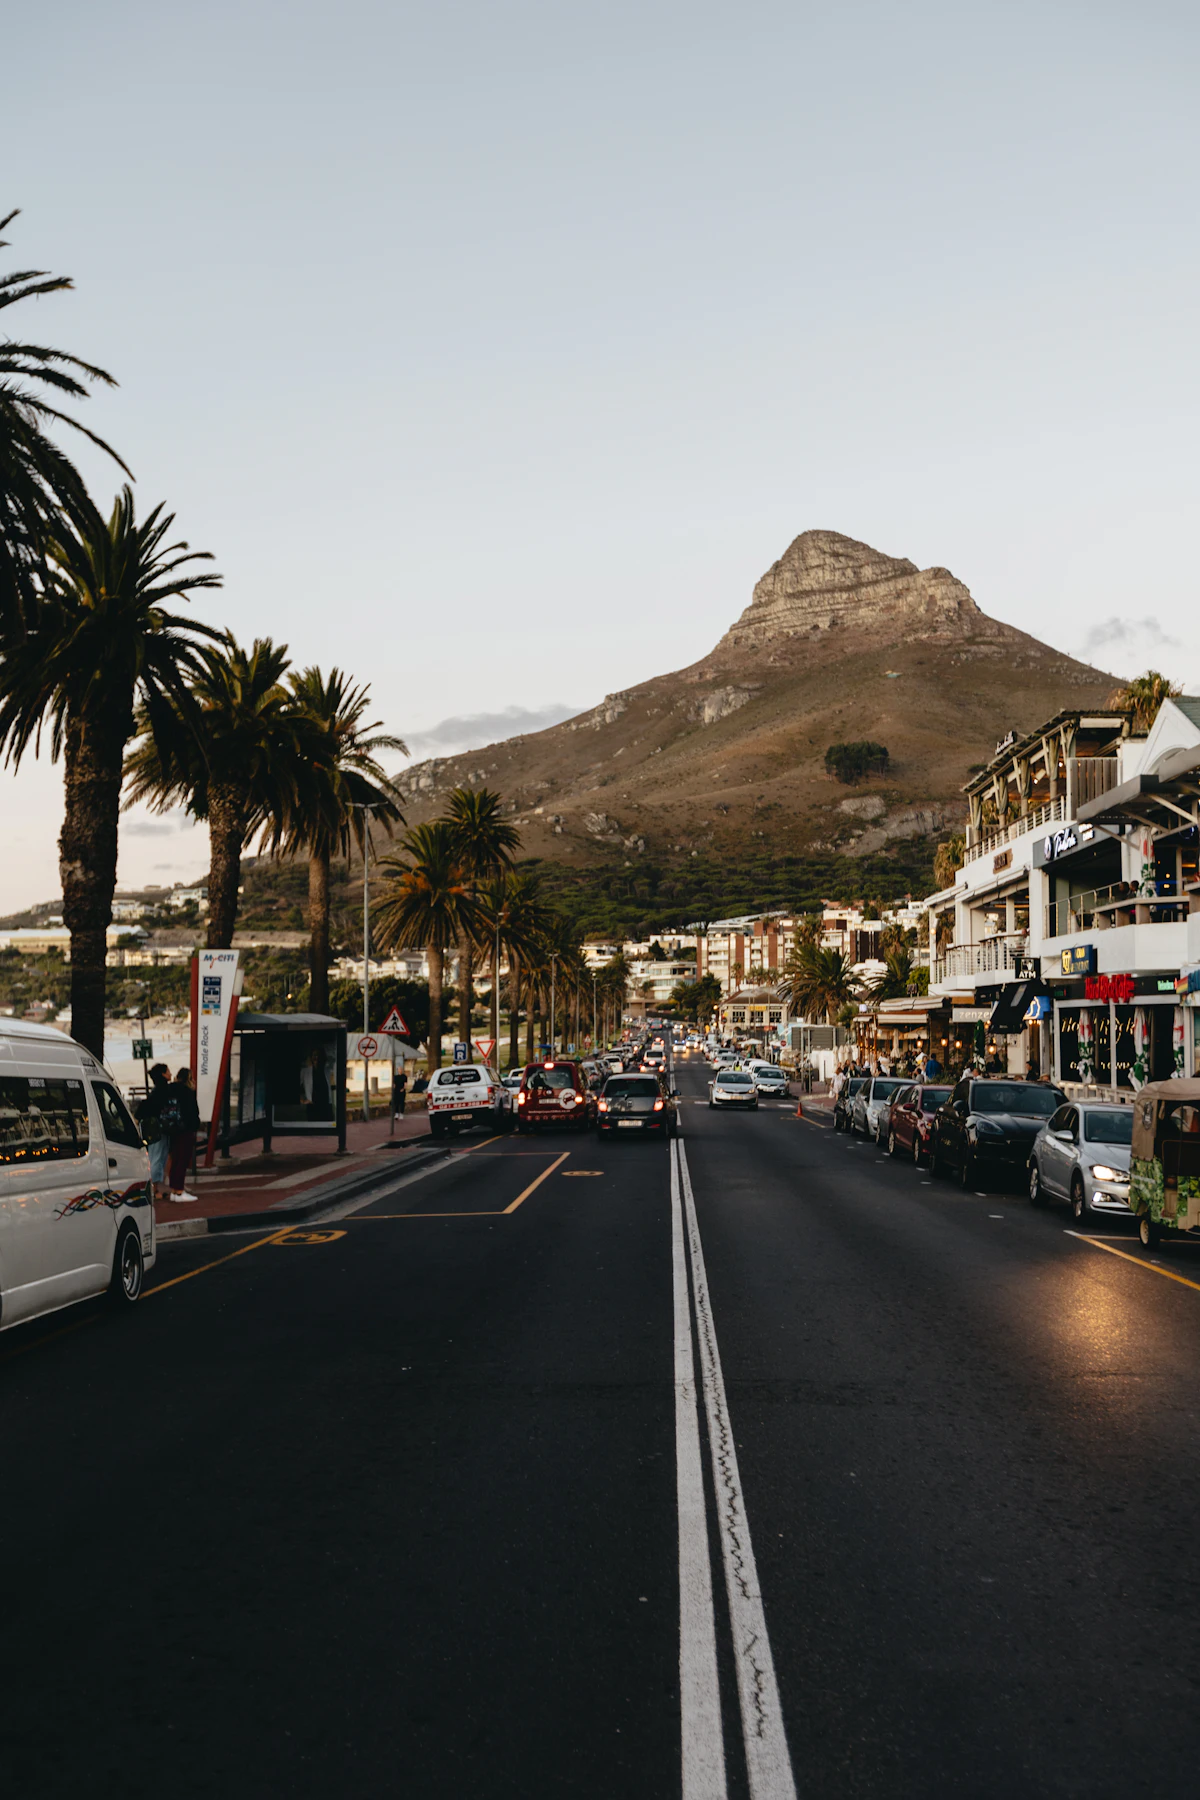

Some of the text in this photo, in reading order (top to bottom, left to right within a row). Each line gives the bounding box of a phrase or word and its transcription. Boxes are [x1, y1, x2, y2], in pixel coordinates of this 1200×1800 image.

[1018, 971, 1037, 979] ATM
[201, 1025, 209, 1076] Whale Rock
[456, 1051, 464, 1059] R
